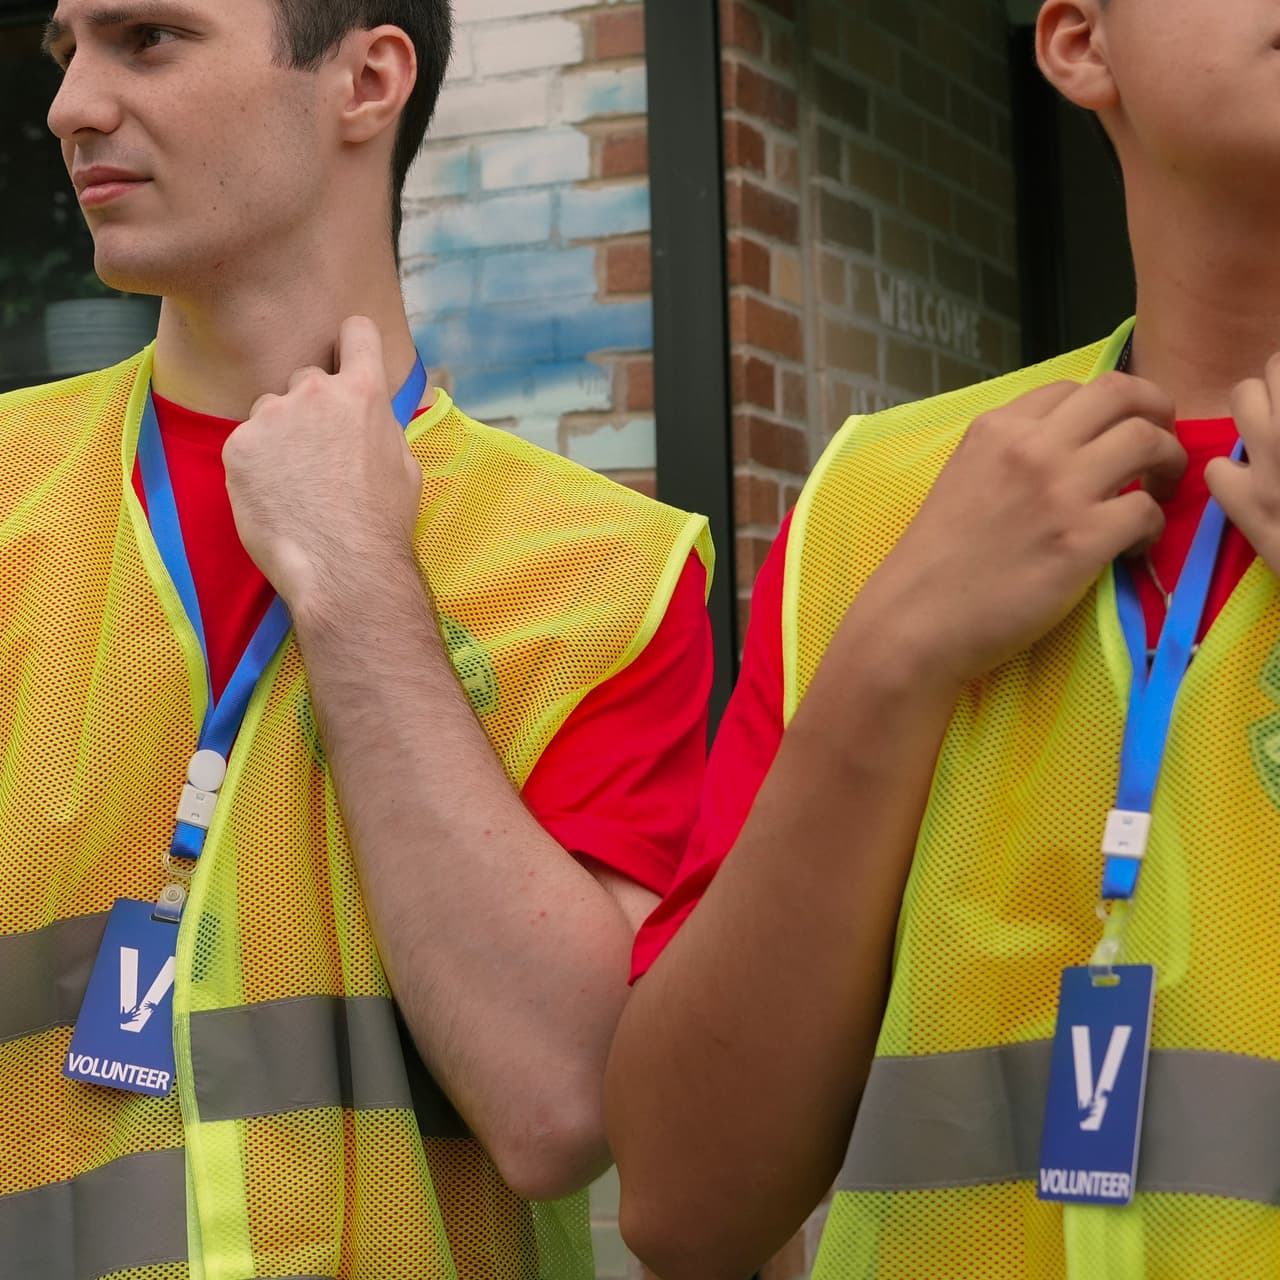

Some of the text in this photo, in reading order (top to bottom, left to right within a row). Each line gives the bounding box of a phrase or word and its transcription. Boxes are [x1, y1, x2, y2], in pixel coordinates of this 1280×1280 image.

[873, 271, 981, 360] WELCOME
[69, 1053, 170, 1091] VOLUNTEER
[1040, 1168, 1132, 1198] VOLUNTEER
